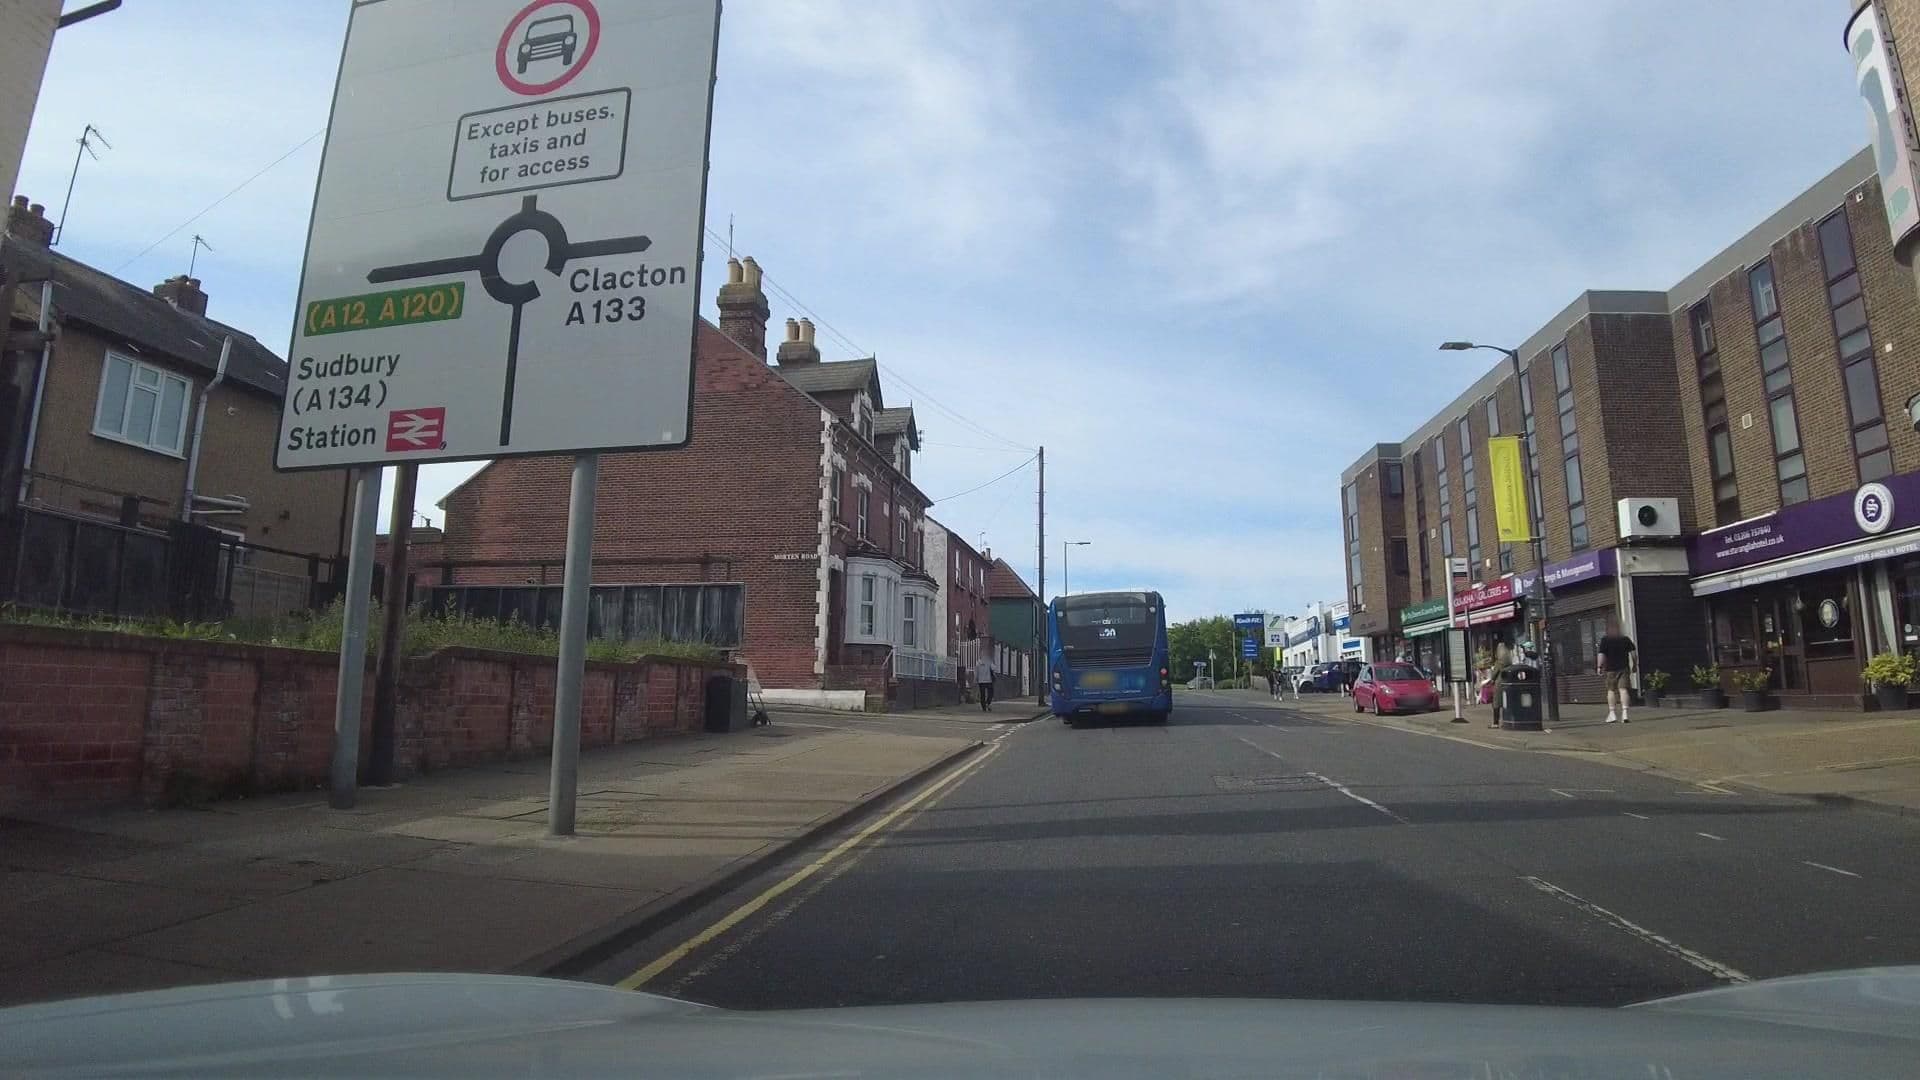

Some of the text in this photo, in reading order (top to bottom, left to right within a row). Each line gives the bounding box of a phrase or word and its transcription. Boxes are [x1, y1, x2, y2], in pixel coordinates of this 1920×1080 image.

[467, 113, 539, 140] Except
[489, 128, 587, 160] taxis and
[480, 155, 590, 183] for access
[569, 264, 686, 293] Clacton
[379, 287, 460, 321] A120)
[565, 296, 646, 326] A133
[297, 353, 401, 380] Sudbury
[293, 380, 387, 416] (A134)
[287, 424, 377, 451] Station
[801, 552, 818, 560] ROAD
